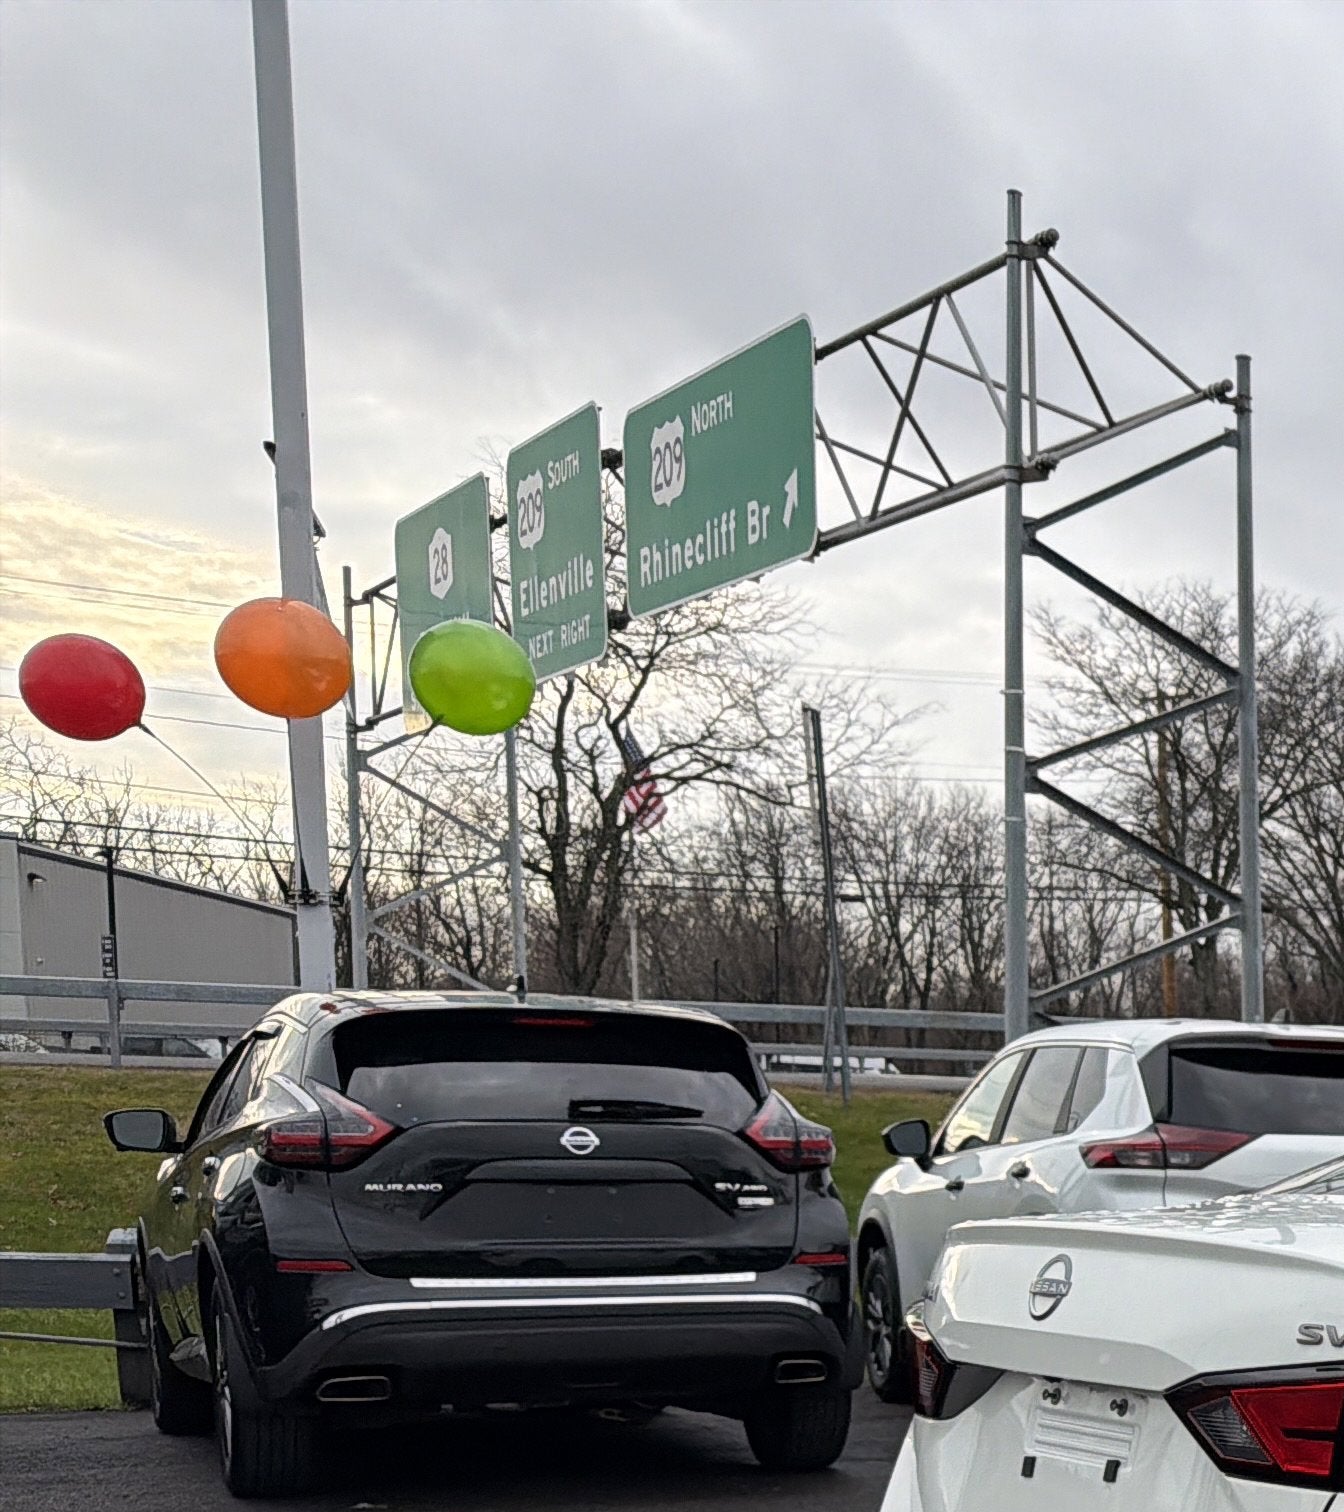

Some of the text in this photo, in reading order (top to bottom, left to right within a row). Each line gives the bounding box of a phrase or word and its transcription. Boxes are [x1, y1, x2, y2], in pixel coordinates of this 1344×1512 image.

[691, 390, 733, 437] NORTH
[547, 450, 579, 490] SOUTH
[653, 436, 683, 492] 209
[519, 488, 542, 537] 209
[433, 543, 449, 586] 28
[640, 500, 771, 588] Rhinecliff Br
[520, 553, 594, 617] Ellenville
[528, 614, 590, 661] NEXT RIGHT
[364, 1183, 443, 1192] MURANO
